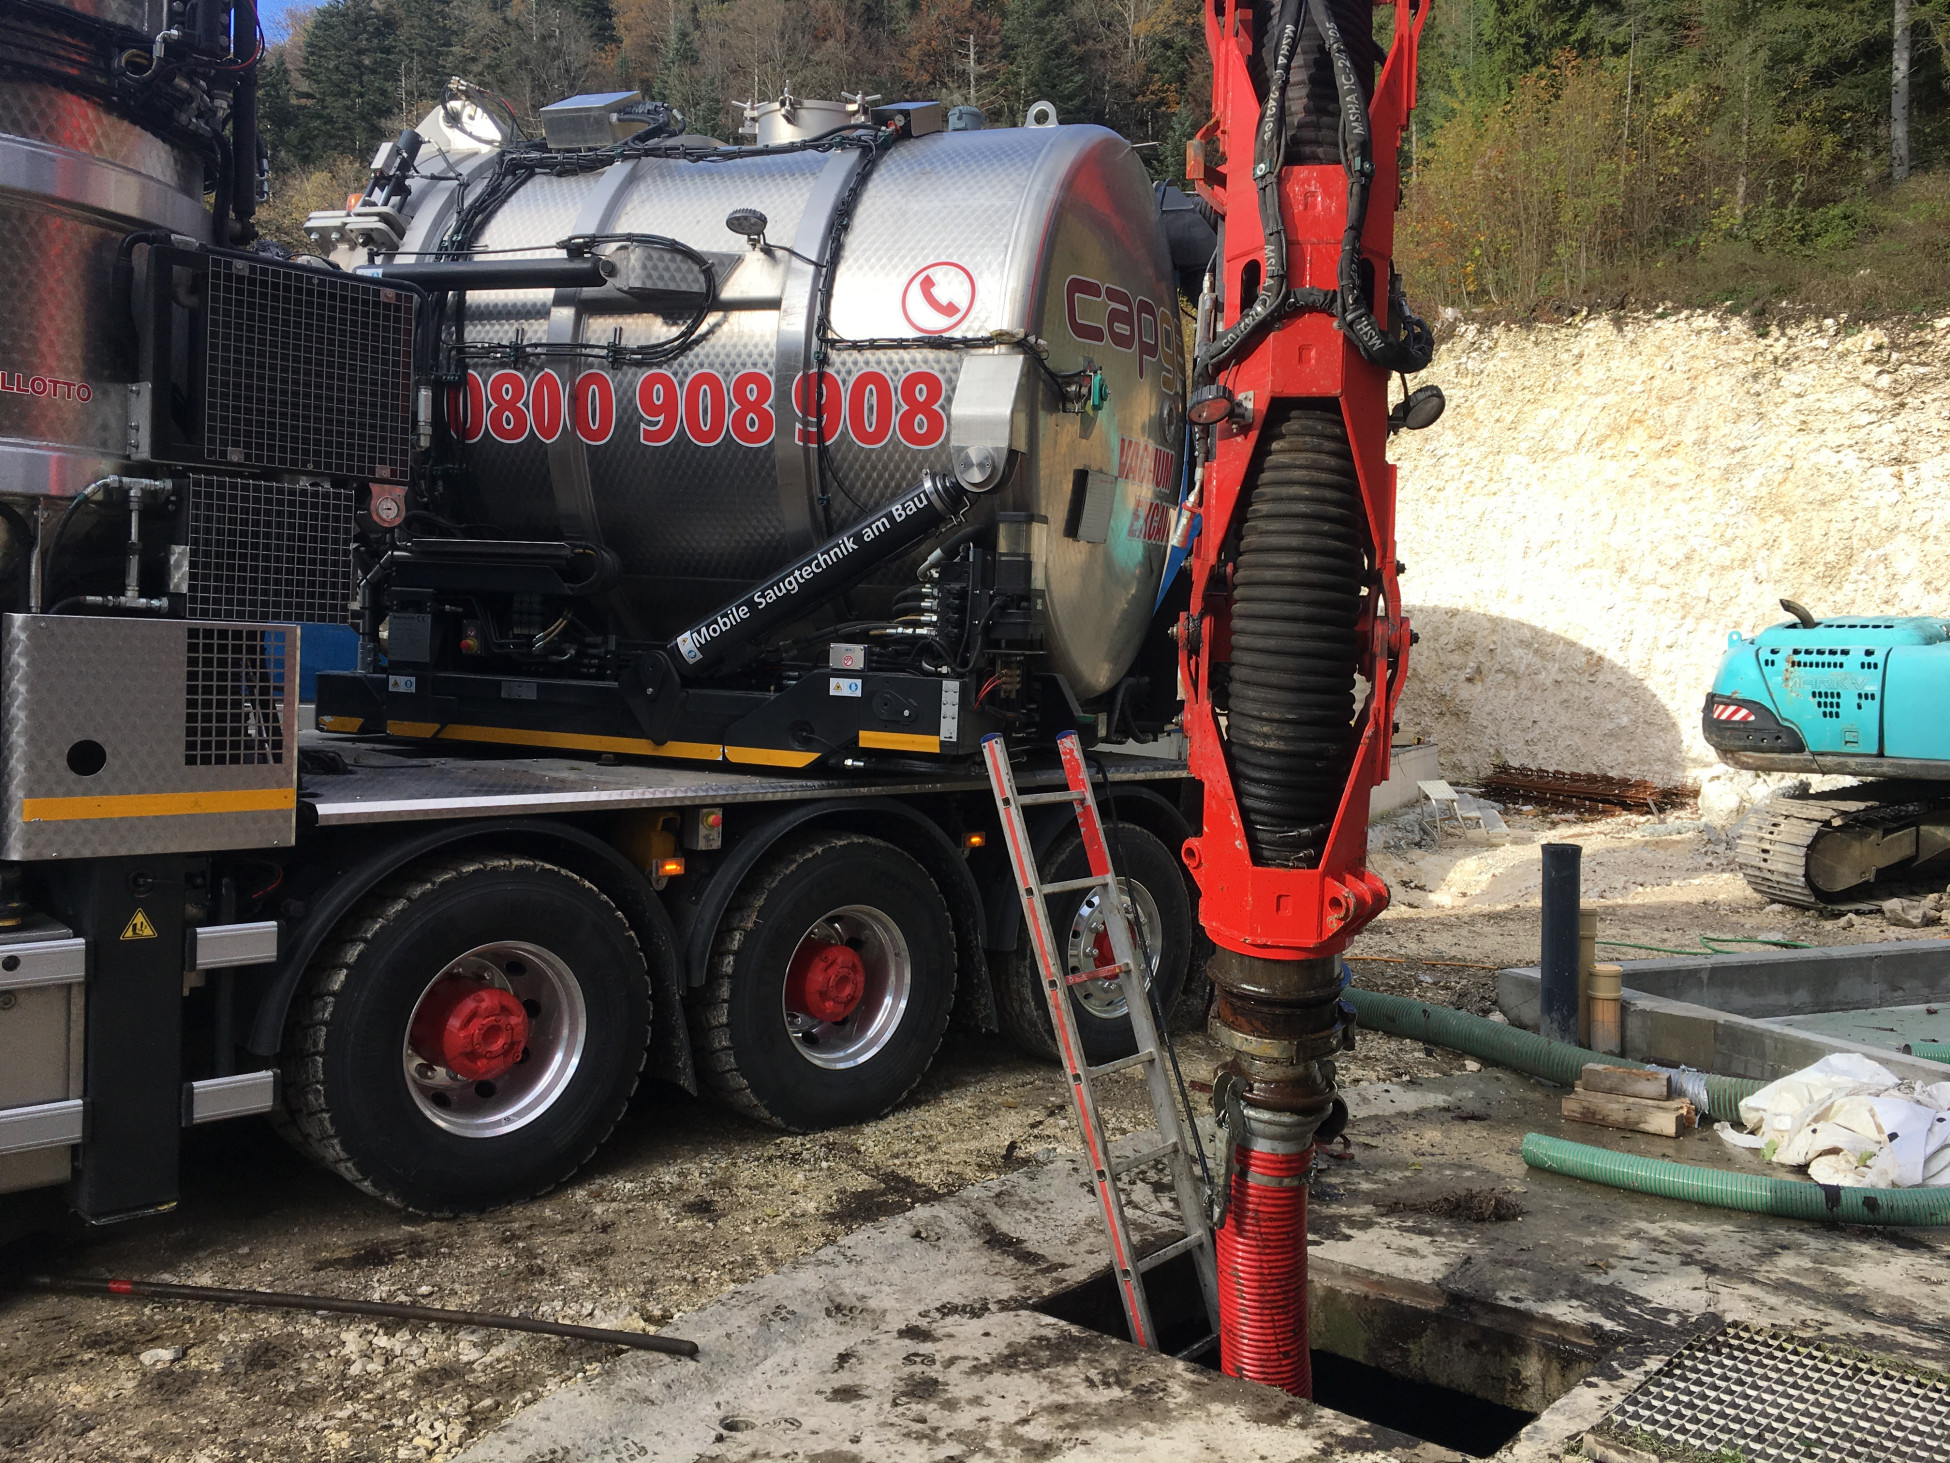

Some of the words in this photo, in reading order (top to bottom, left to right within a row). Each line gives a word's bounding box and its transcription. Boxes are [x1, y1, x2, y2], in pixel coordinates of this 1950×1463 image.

[1278, 24, 1296, 66] MSHA
[1345, 92, 1366, 135] MSHA
[0, 370, 93, 403] LLOTTO
[444, 367, 616, 446] 0800
[637, 368, 776, 447] 908
[791, 368, 948, 450] 908
[1117, 435, 1176, 493] VACUUM
[691, 604, 751, 649] Mobile
[753, 535, 859, 610] Saugtechnik
[861, 516, 892, 543] am
[890, 492, 929, 524] Bau
